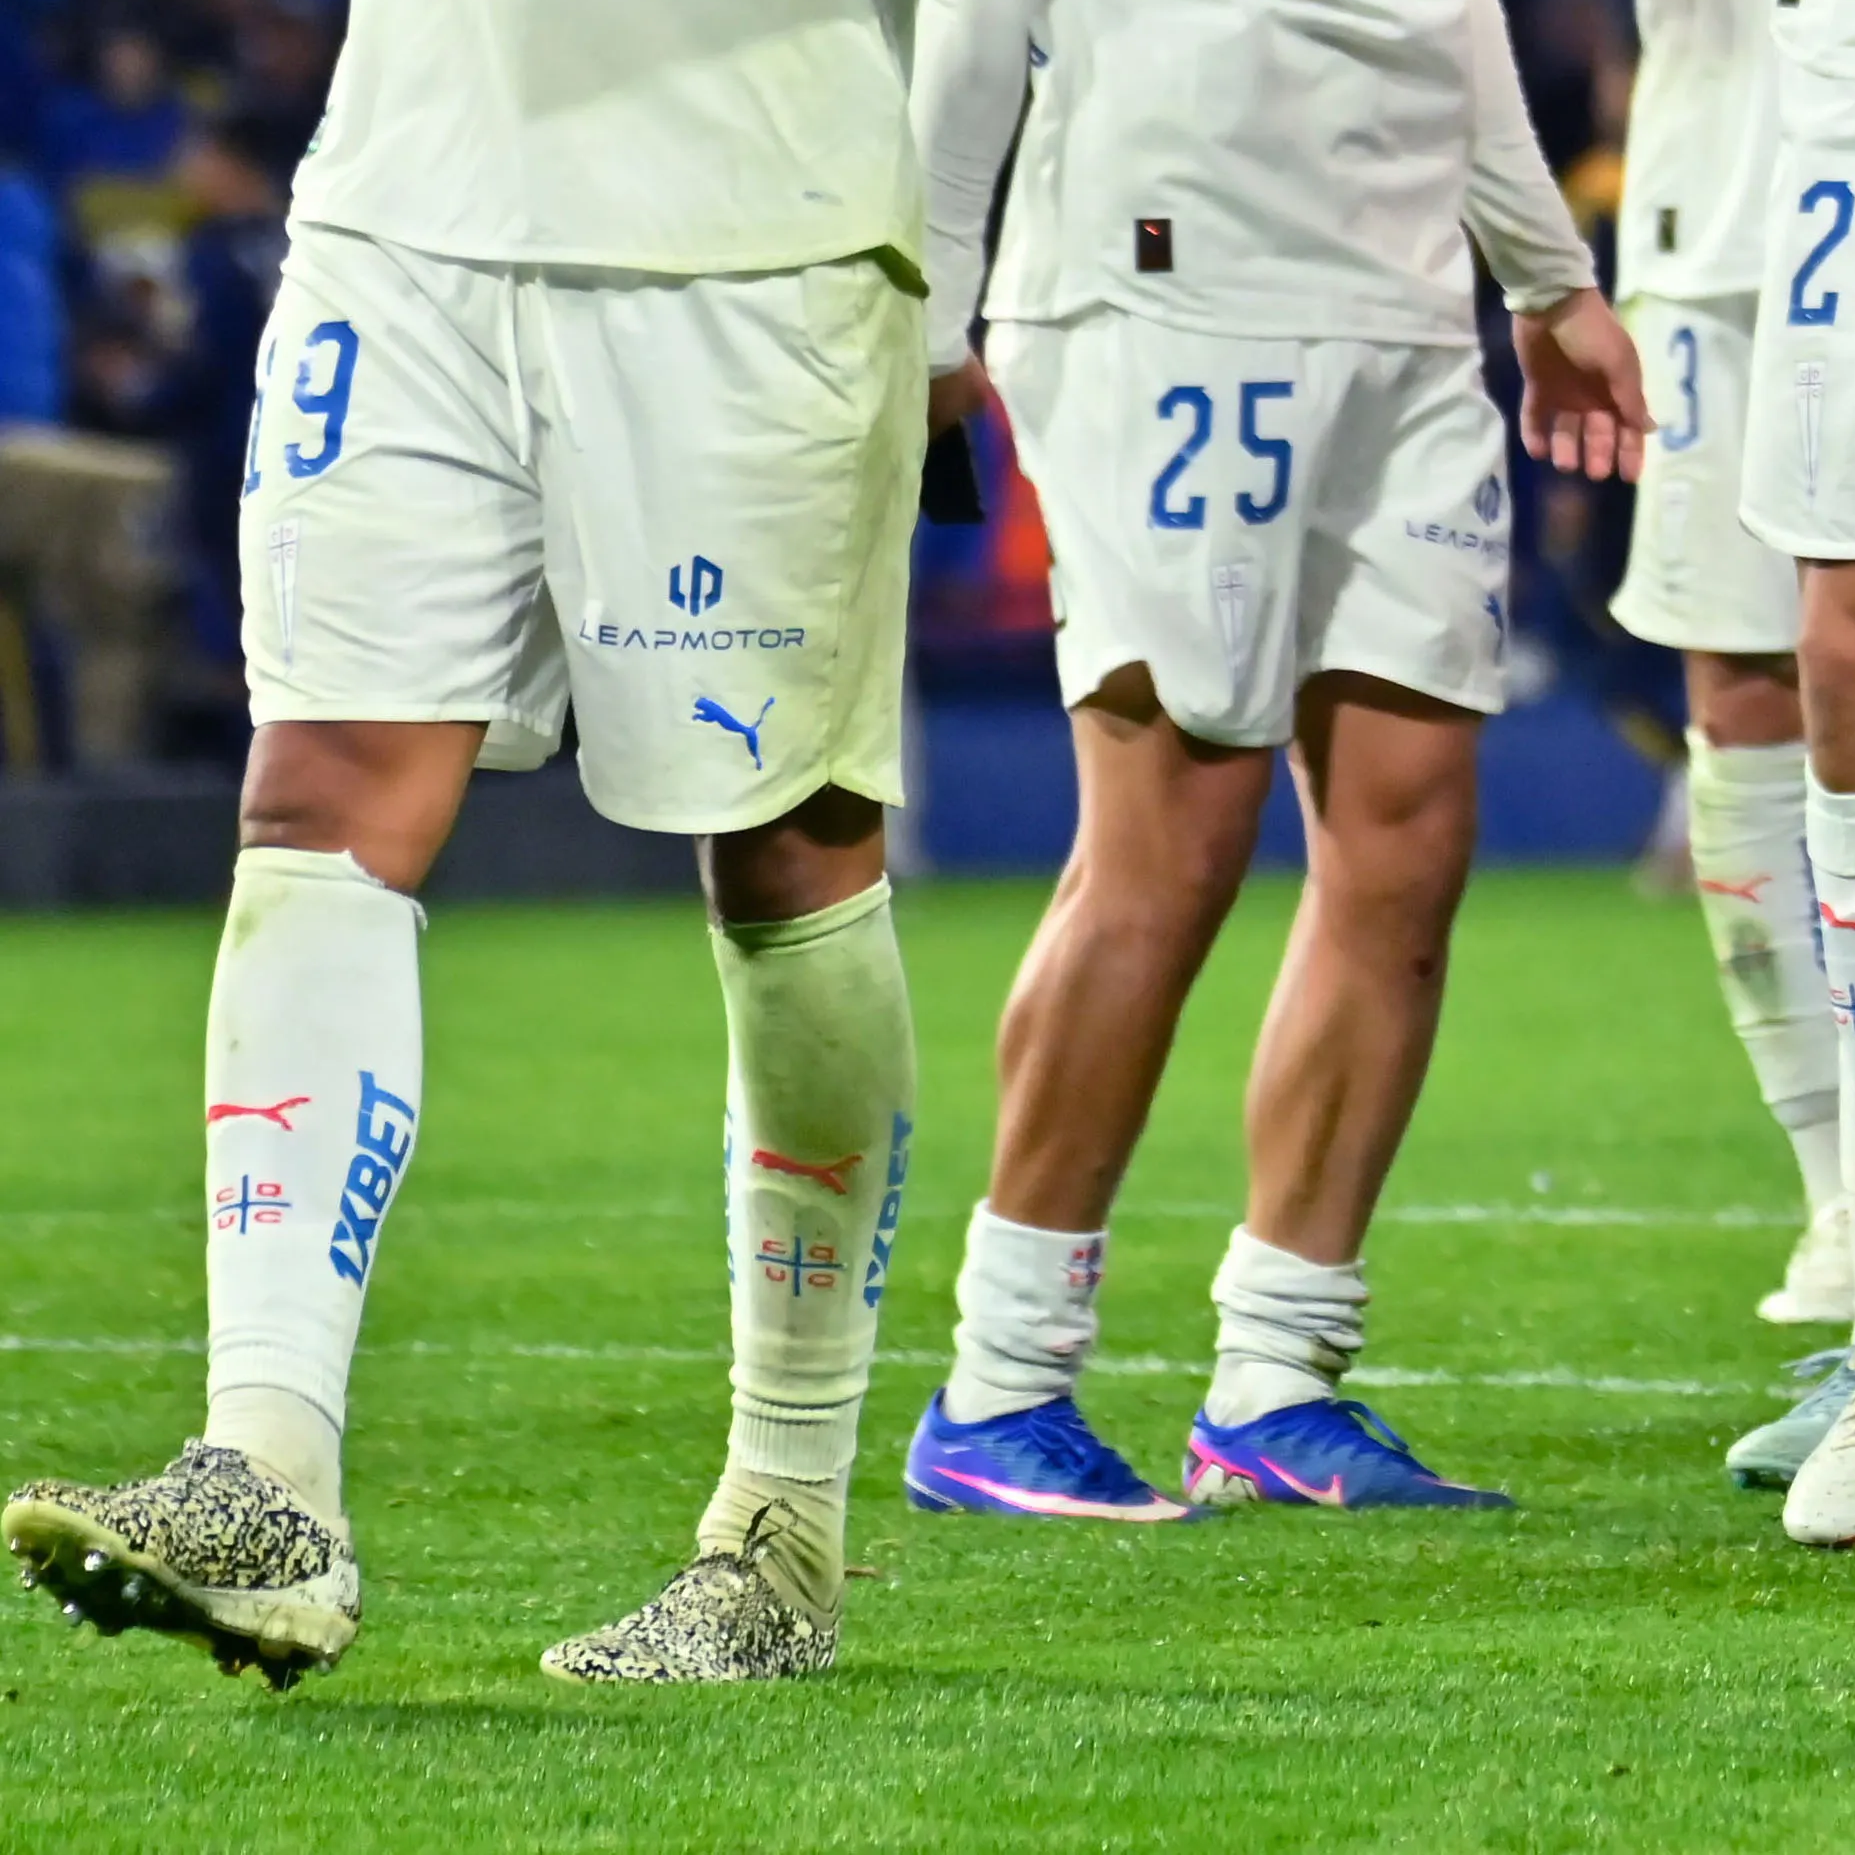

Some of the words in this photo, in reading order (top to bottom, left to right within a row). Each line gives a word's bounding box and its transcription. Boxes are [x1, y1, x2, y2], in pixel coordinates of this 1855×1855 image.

[1788, 180, 1855, 326] 2
[1149, 382, 1296, 531] 25
[579, 619, 806, 652] LEAPMOTOR
[328, 1070, 416, 1299] 1XBET
